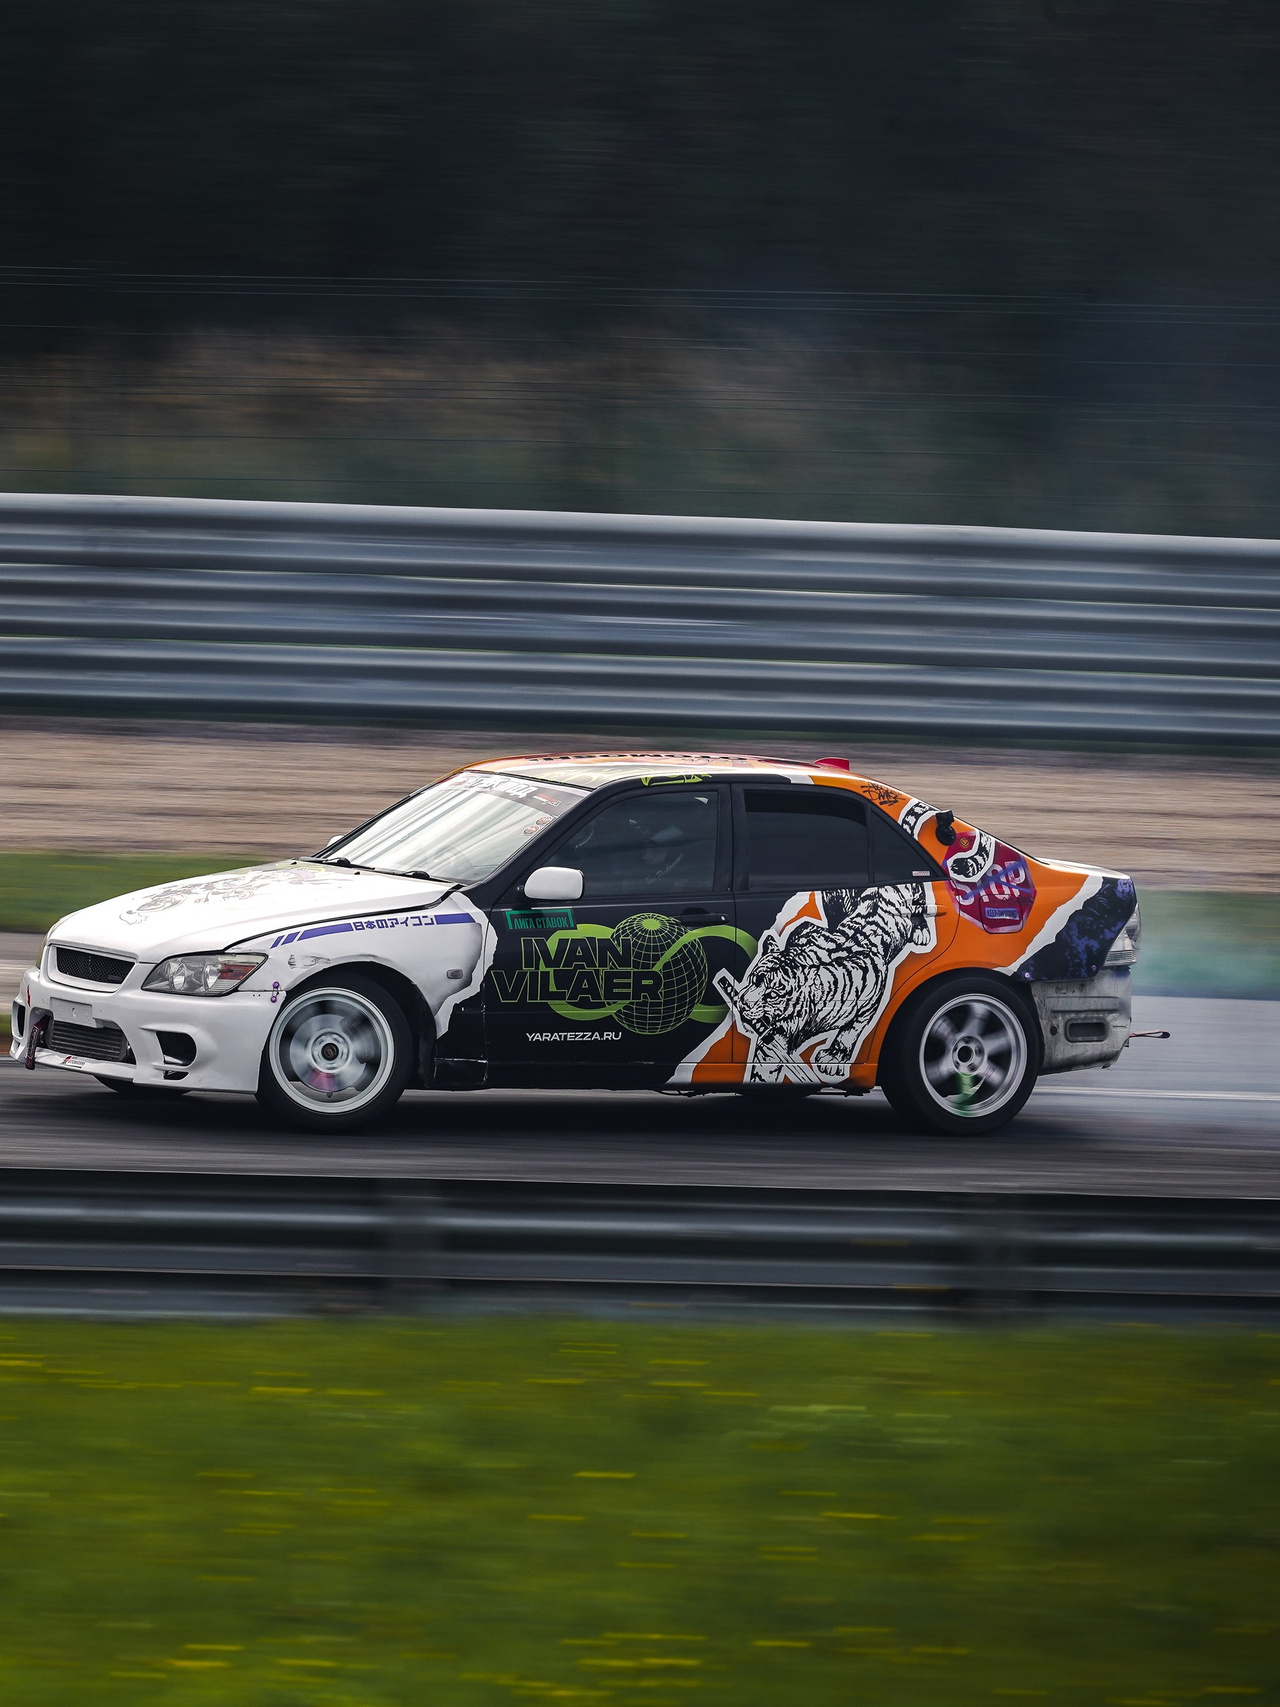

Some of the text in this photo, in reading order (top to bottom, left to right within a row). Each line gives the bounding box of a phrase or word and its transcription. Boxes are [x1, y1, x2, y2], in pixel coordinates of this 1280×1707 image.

[950, 861, 1026, 906] STOP
[352, 915, 435, 931] 日本のアイコン
[514, 916, 569, 930] ЛИГА СТАВОК
[521, 936, 633, 971] IVAN
[491, 969, 665, 1003] VILAER
[526, 1031, 623, 1042] YARATEZZA.RU
